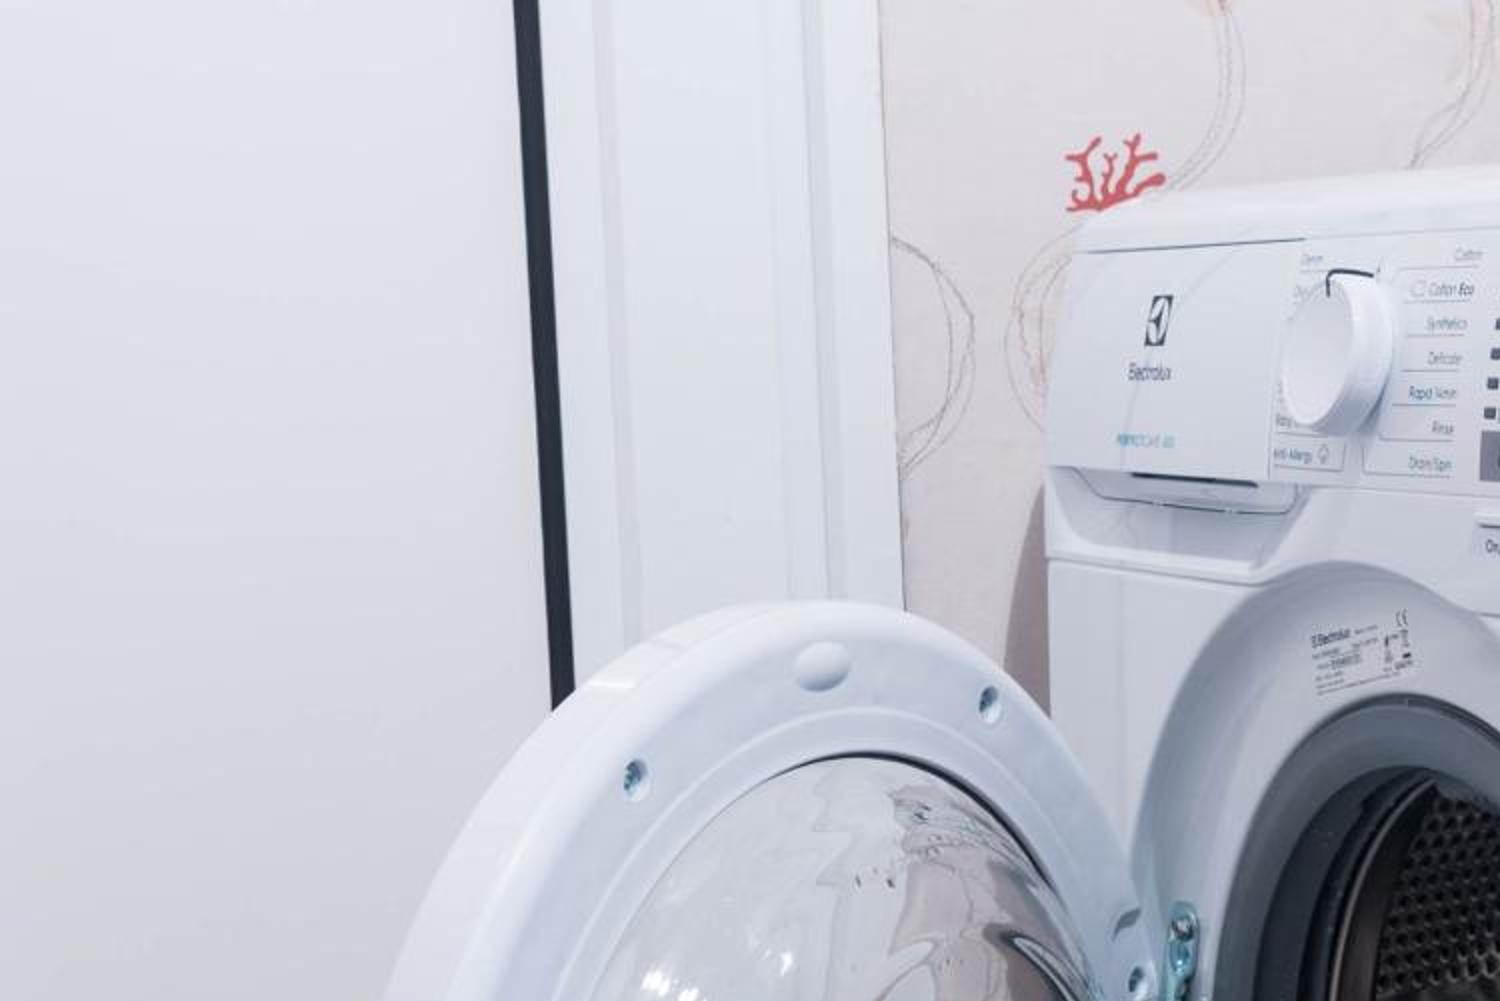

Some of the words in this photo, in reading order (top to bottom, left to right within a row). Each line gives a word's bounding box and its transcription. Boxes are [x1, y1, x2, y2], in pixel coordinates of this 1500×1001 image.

[1457, 281, 1474, 297] Eco
[1128, 362, 1171, 381] Electrolux
[1408, 385, 1432, 399] Rapid
